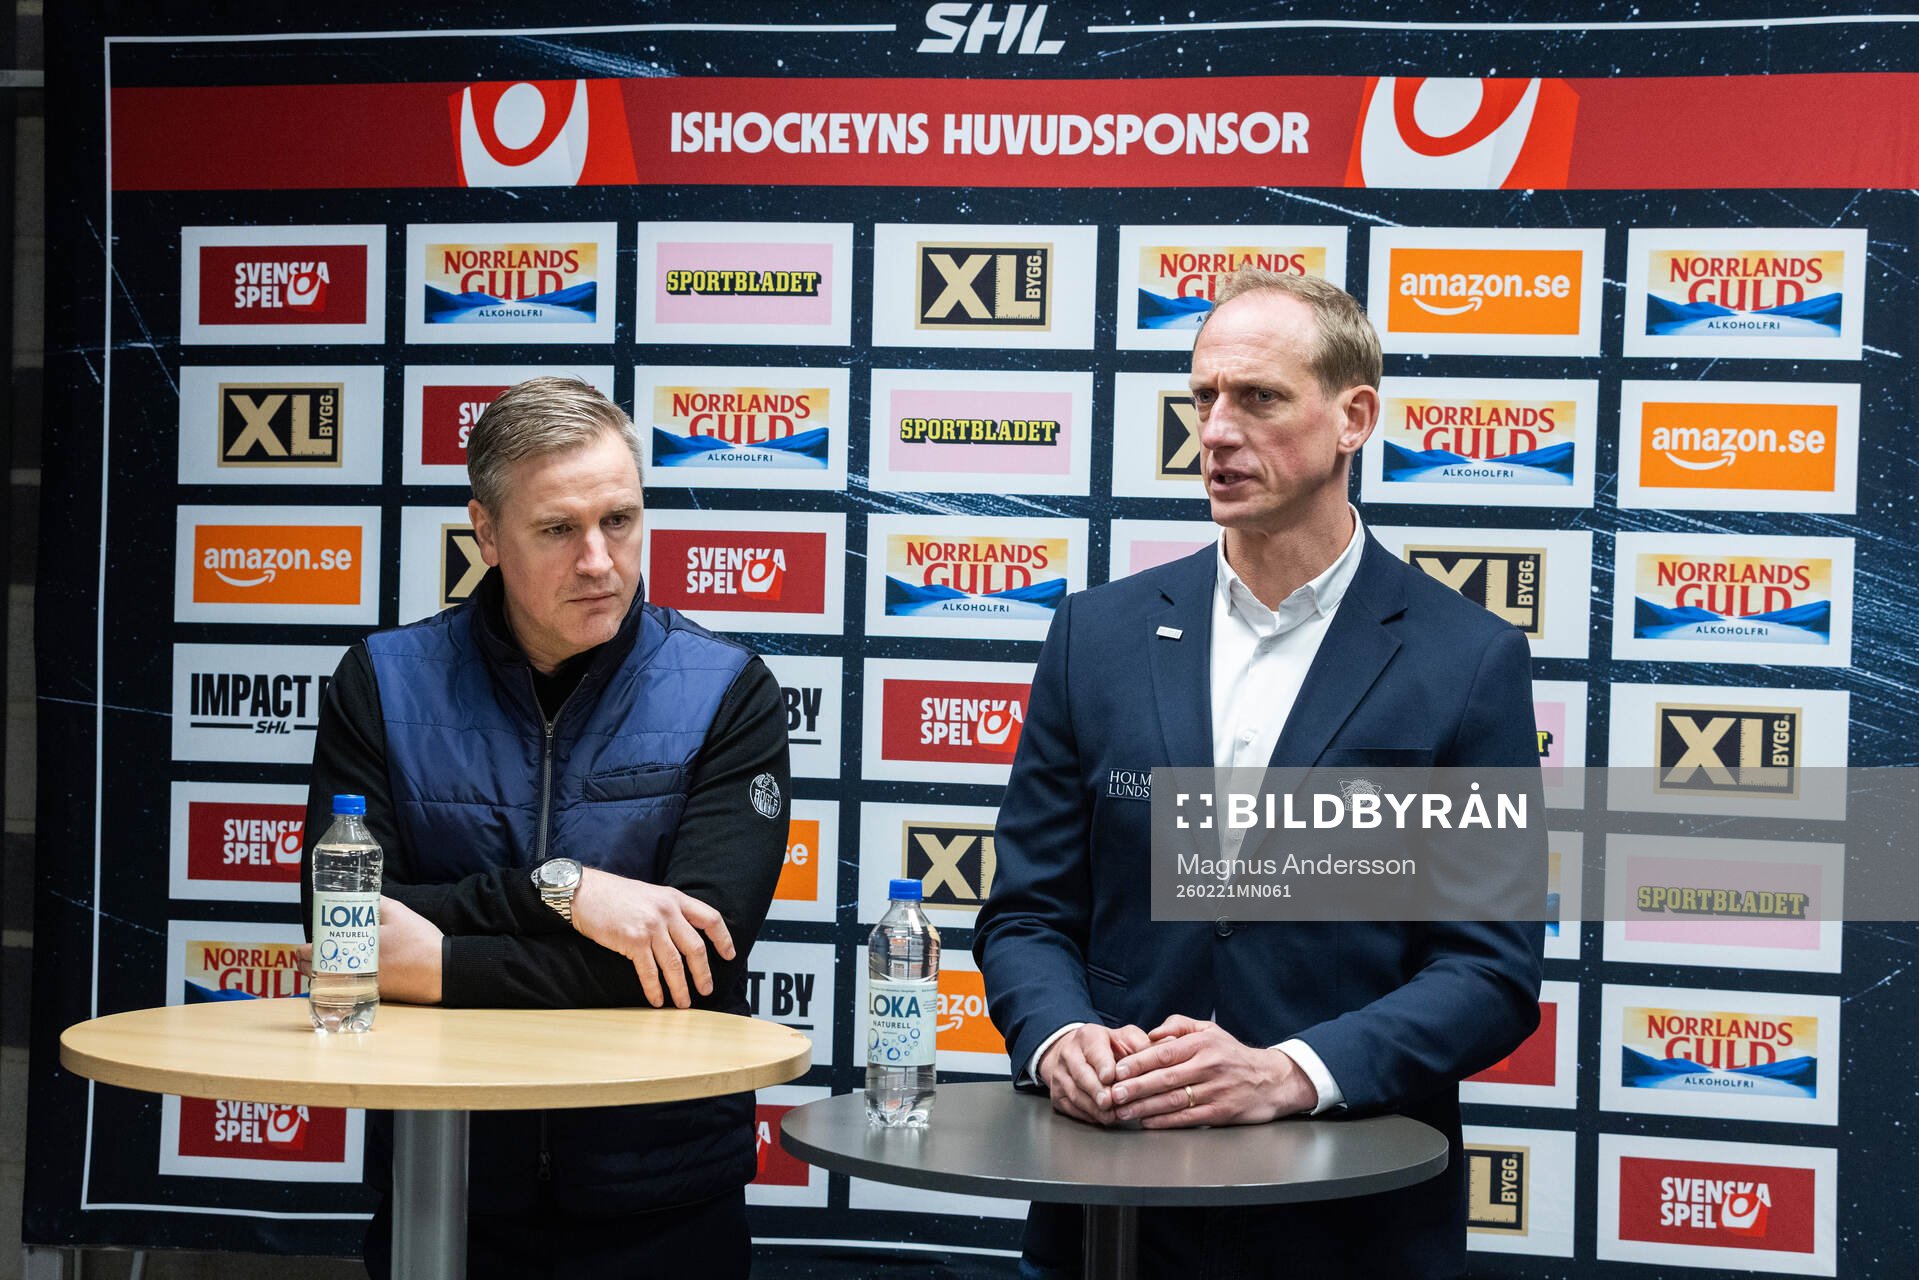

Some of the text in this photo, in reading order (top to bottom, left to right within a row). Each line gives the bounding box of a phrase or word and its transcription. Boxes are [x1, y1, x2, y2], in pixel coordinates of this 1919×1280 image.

[916, 2, 1067, 55] SHL
[670, 111, 1310, 156] ISHOCKEYNS HUVUDSPONSOR
[444, 249, 580, 275] NORRLANDS
[1160, 253, 1306, 278] NORRLANDS
[1669, 256, 1824, 285] NORRLANDS
[460, 270, 566, 301] GULD
[667, 270, 822, 297] SPORTBLADET
[923, 253, 1041, 320] XL
[1025, 254, 1042, 300] BYGG
[1400, 271, 1571, 299] amazon.se
[234, 285, 283, 309] SPEL
[1687, 277, 1805, 312] GULD
[479, 308, 543, 319] ALKOHOLFRI
[1707, 320, 1781, 331] ALKOHOLFRI
[318, 394, 334, 438] BYGG
[672, 392, 811, 420] NORRLANDS
[1405, 405, 1556, 434] NORRLANDS
[225, 394, 333, 457] XL
[689, 413, 795, 445] GULD
[900, 417, 1061, 446] SPORTBLADET
[1165, 403, 1200, 468] X
[1422, 426, 1538, 461] GULD
[1652, 426, 1826, 455] amazon.se
[707, 453, 774, 463] ALKOHOLFRI
[1442, 467, 1515, 479] ALKOHOLFRI
[203, 546, 353, 571] amazon.se
[906, 541, 1049, 571] NORRLANDS
[686, 570, 738, 595] SPEL
[923, 562, 1032, 595] GULD
[1517, 560, 1535, 606] BYGG
[1656, 560, 1811, 591] NORRLANDS
[942, 603, 1011, 613] ALKOHOLFRI
[1675, 583, 1793, 617] GULD
[1696, 625, 1769, 637] ALKOHOLFRI
[190, 673, 312, 718] IMPACT
[254, 720, 291, 735] SHL
[920, 721, 973, 746] SPEL
[1662, 714, 1789, 788] XL
[1772, 719, 1791, 767] BYGG
[1110, 770, 1152, 787] HOLM
[223, 819, 303, 843] SVENSK
[223, 842, 272, 866] SPEL
[321, 905, 376, 927] LOKA
[1637, 886, 1810, 920] SPORTBLADET
[203, 947, 300, 971] NORRLAN
[772, 972, 815, 1018] BY
[869, 992, 921, 1018] LOKA
[873, 1020, 911, 1029] NATURELL
[1647, 1014, 1794, 1047] NORRLANDS
[1664, 1036, 1777, 1070] GULD
[1684, 1076, 1755, 1089] ALKOHOLFRI
[214, 1119, 264, 1144] SPEL
[1501, 1157, 1518, 1203] BYGG
[1660, 1201, 1717, 1230] SPEL
